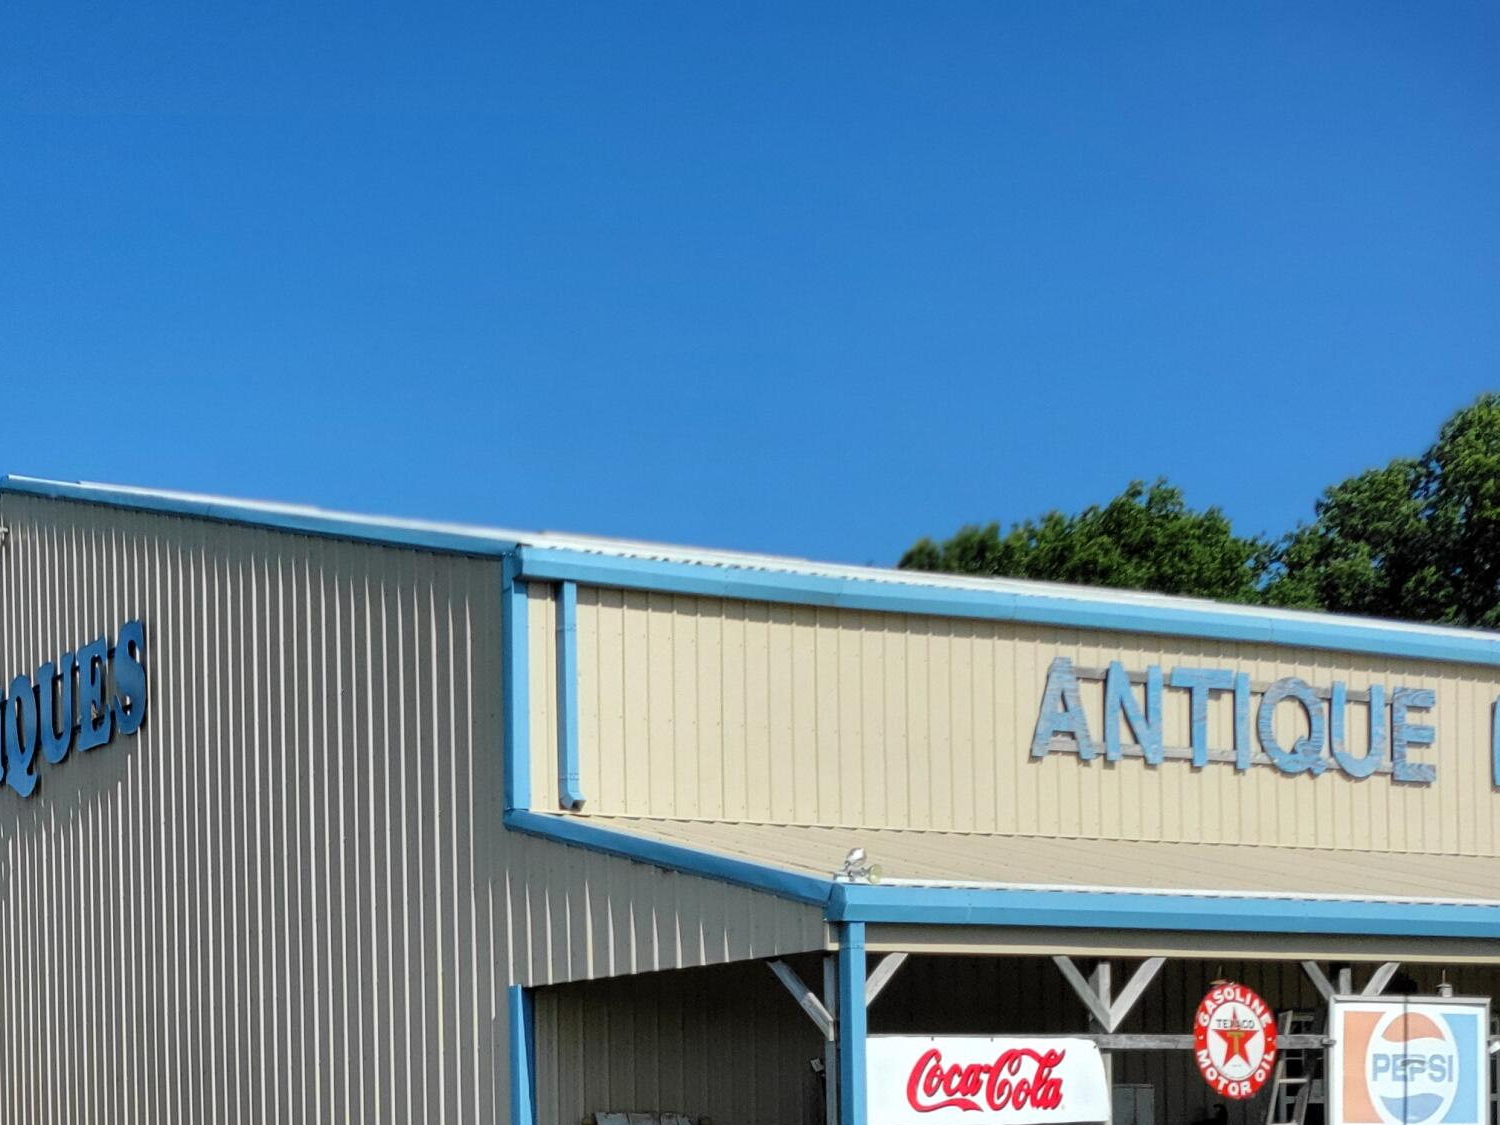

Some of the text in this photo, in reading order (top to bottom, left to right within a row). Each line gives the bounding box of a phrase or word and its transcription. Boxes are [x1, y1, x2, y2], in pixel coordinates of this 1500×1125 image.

[1031, 656, 1436, 783] ANTIQUE
[1198, 987, 1273, 1028] GASOLINE
[1216, 1018, 1256, 1030] TEXACO
[906, 1047, 1066, 1113] Coca-Cola
[1197, 1048, 1275, 1096] MOTOR OIL
[1371, 1053, 1454, 1083] PEPSI
